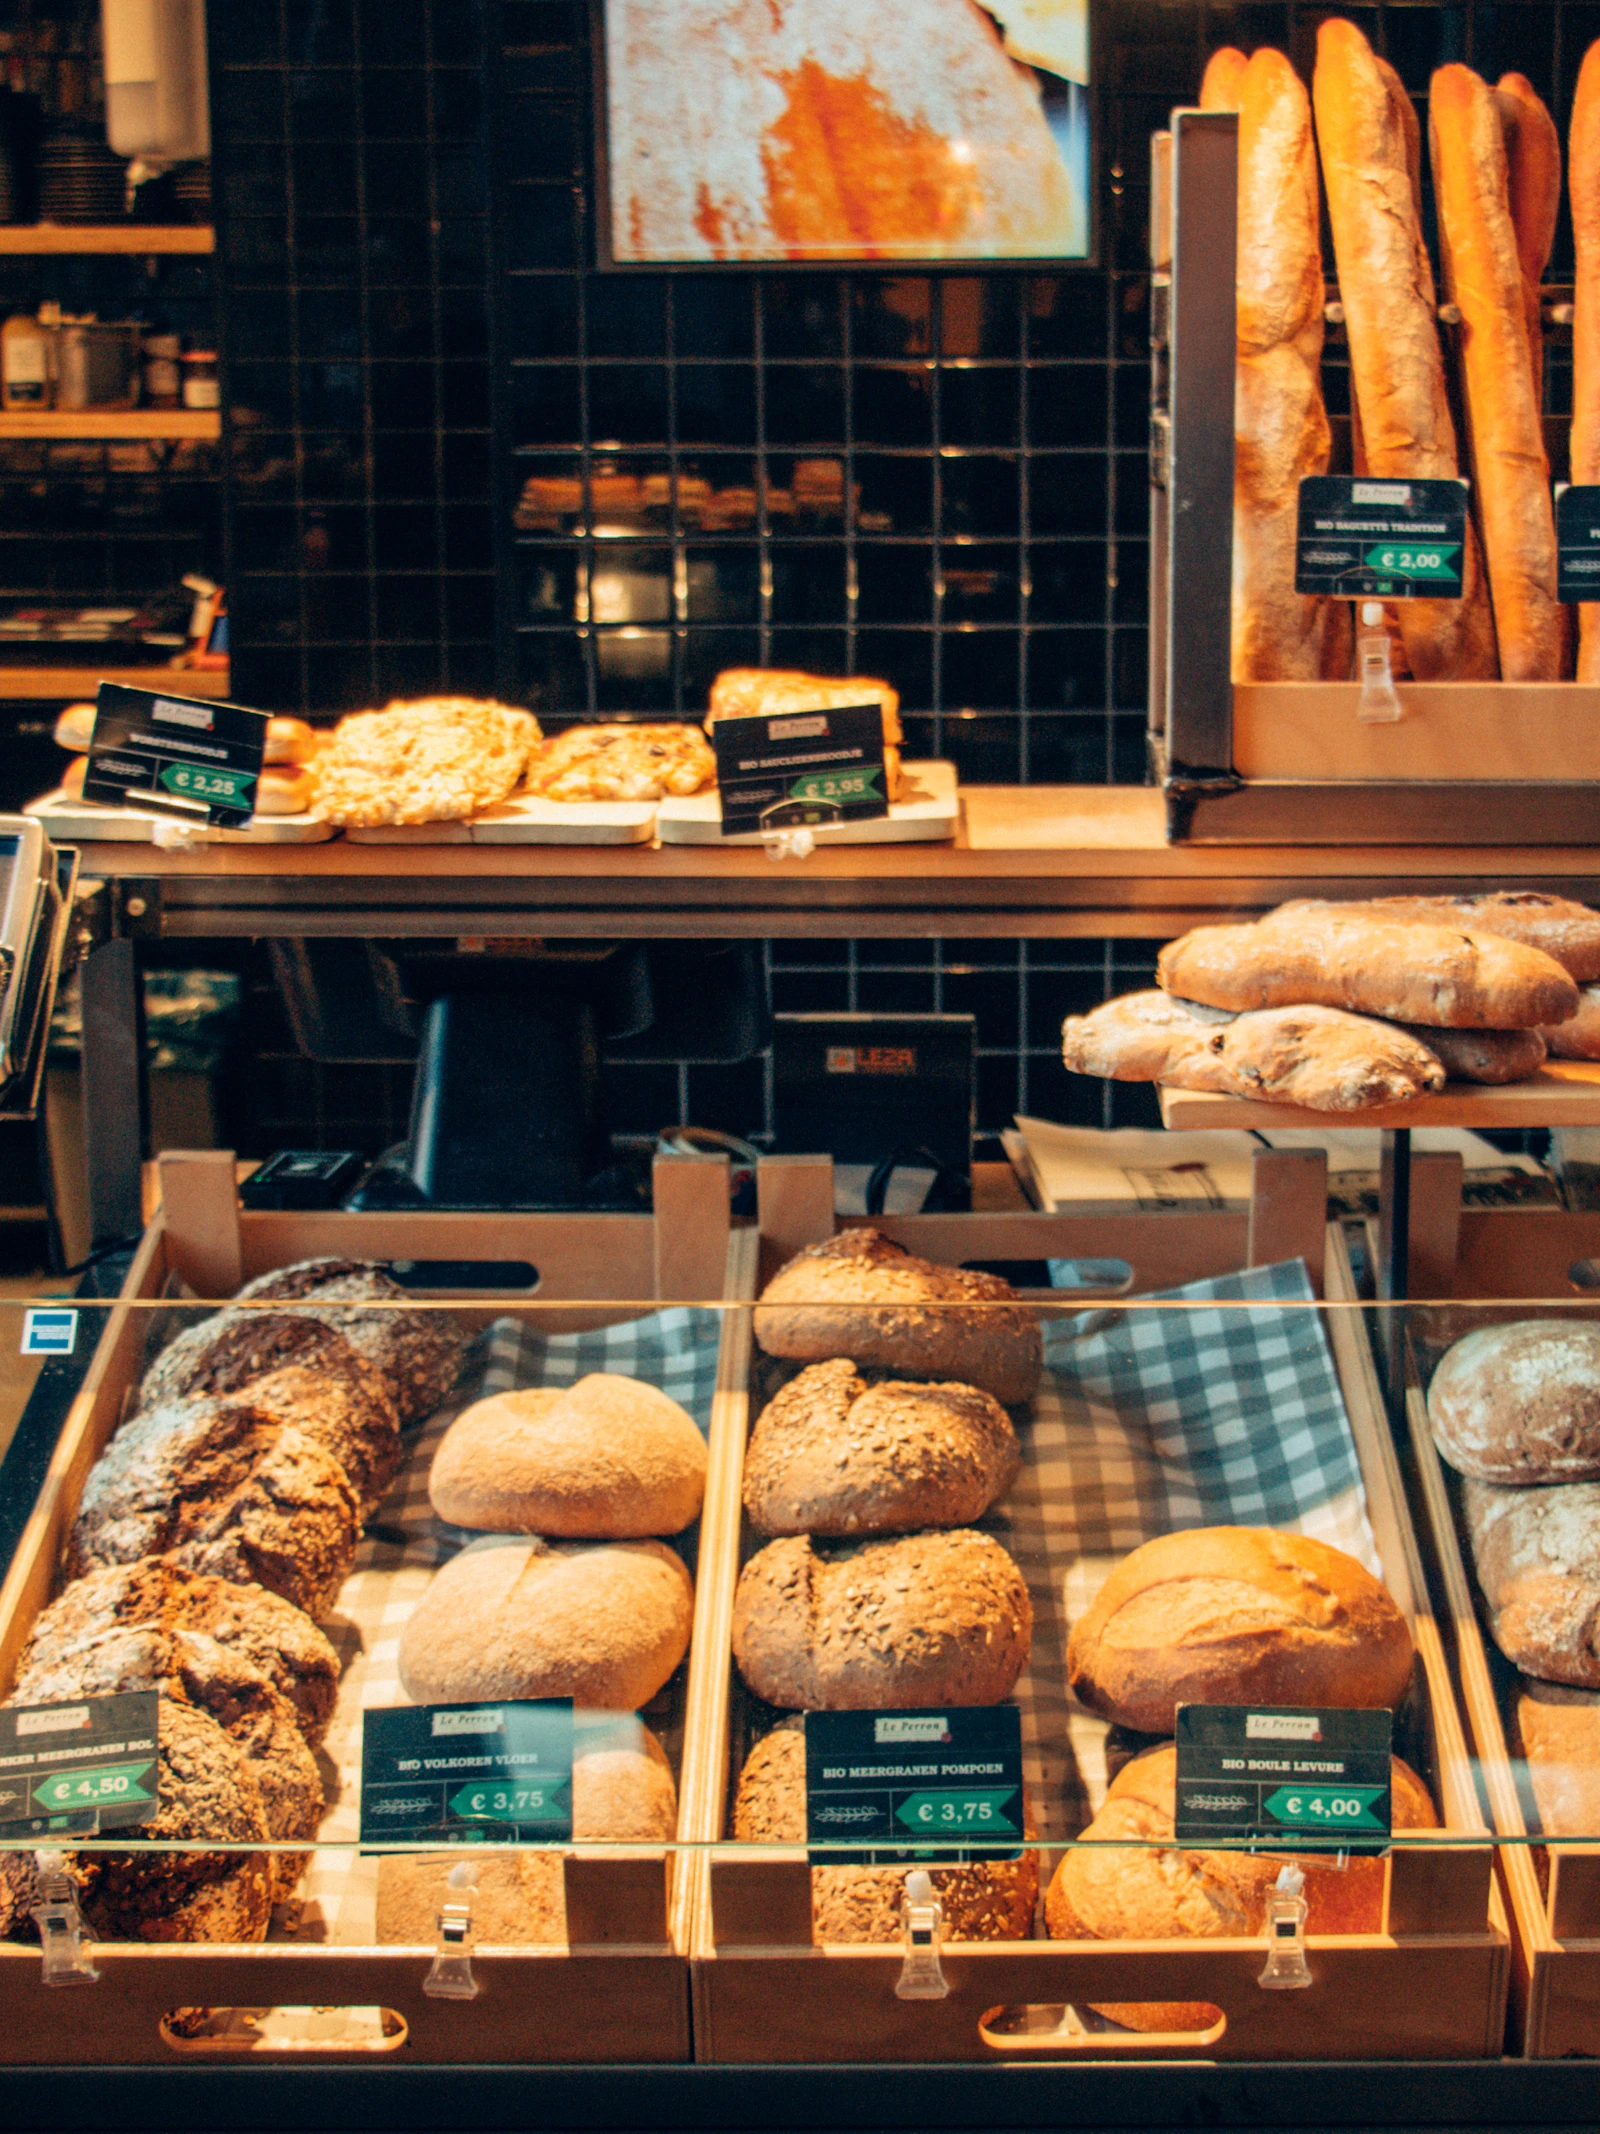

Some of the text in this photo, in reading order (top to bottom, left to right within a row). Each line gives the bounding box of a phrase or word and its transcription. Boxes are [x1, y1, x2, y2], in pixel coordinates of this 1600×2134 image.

[1315, 520, 1447, 533] BIO BAGUETTE TRADITION
[1381, 552, 1441, 569] € 2,00
[738, 759, 759, 771] BIO
[175, 772, 236, 796] € 2,25
[805, 778, 865, 798] € 2,95
[439, 1713, 496, 1726] Le Perron
[883, 1721, 940, 1732] Le Perron
[1254, 1719, 1312, 1730] Le Perron
[37, 1742, 126, 1763] MEERGRANEN
[127, 1739, 155, 1752] BOL
[398, 1753, 539, 1771] BIO VOLKOREN VLOER
[822, 1762, 1004, 1779] BIO MEERGRANEN POMPOEN
[1221, 1758, 1345, 1773] BIO BOULE LEVURE
[54, 1776, 129, 1800] € 4,50
[470, 1791, 544, 1812] € 3,75
[1286, 1796, 1361, 1819] € 4,00
[918, 1802, 993, 1824] € 3,75
